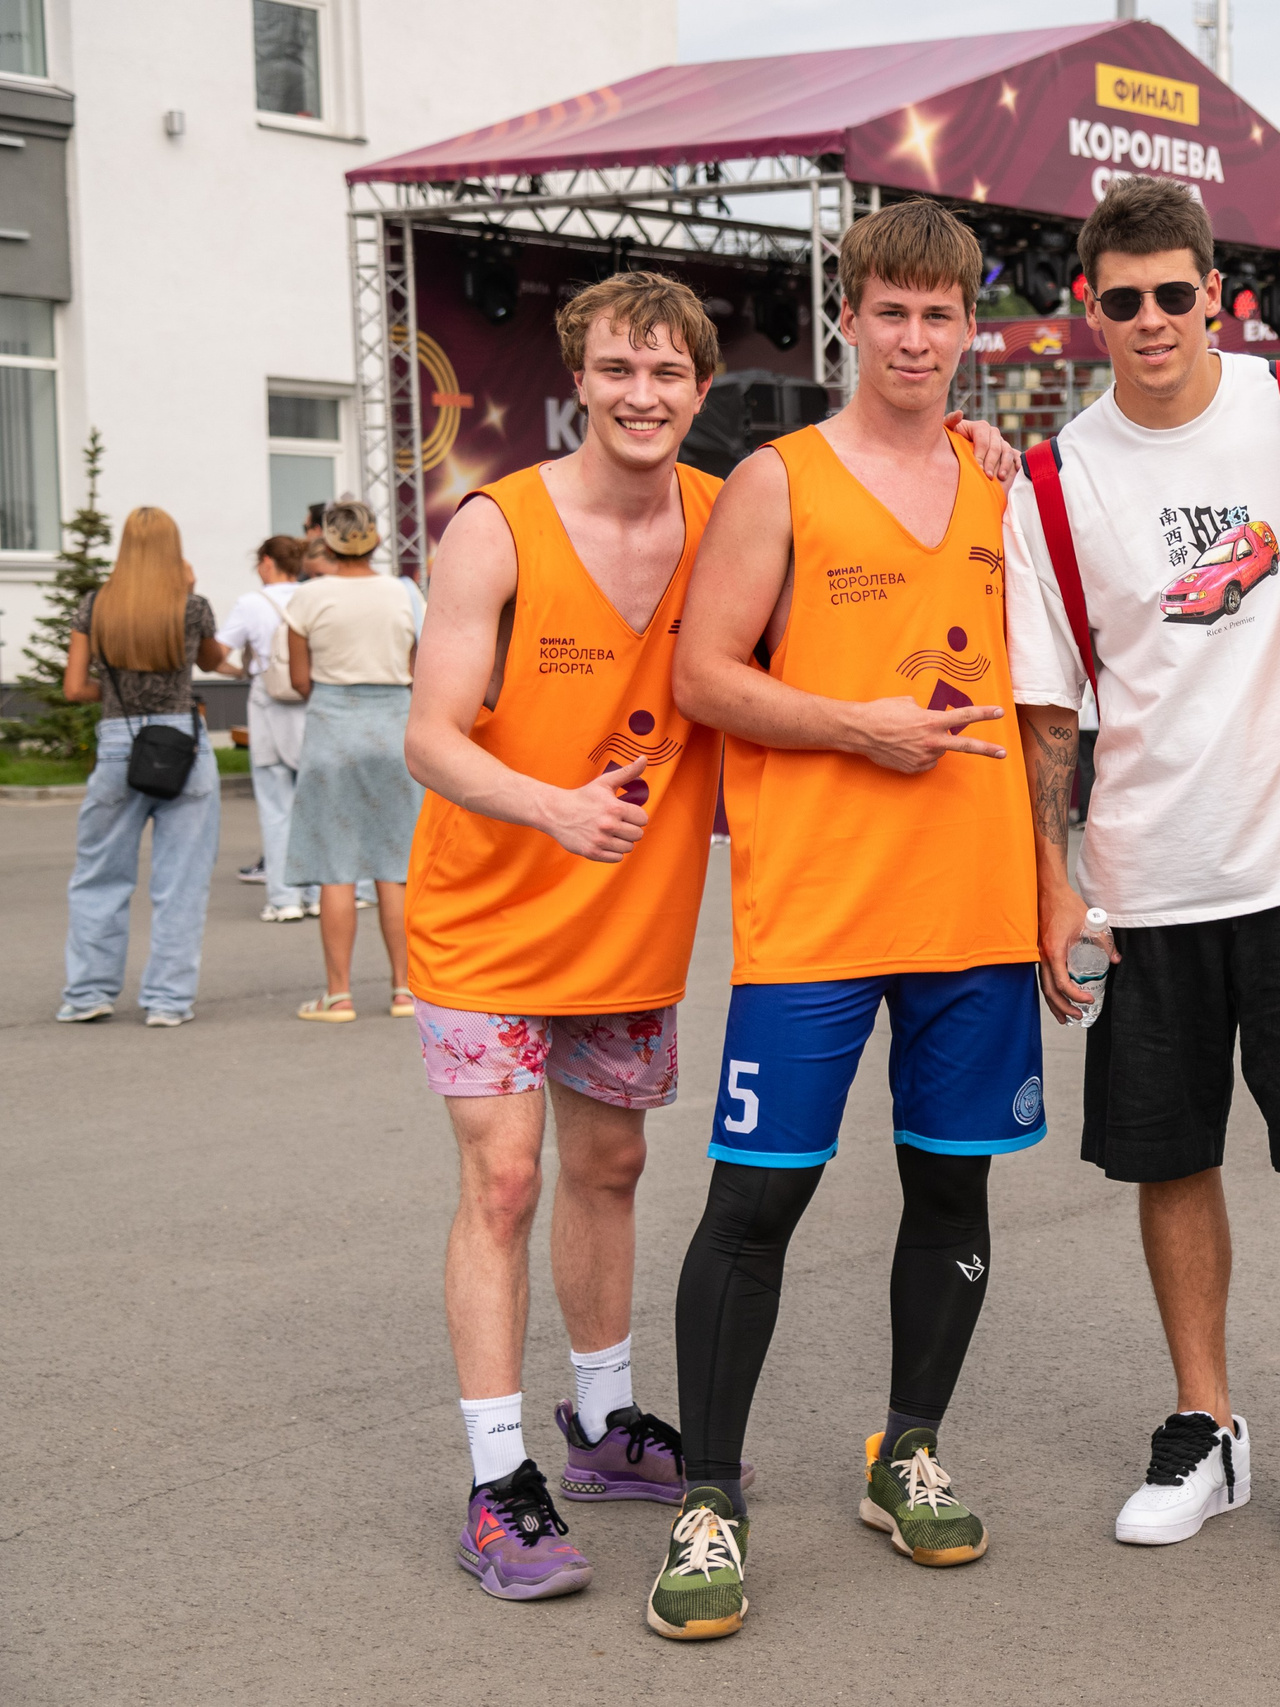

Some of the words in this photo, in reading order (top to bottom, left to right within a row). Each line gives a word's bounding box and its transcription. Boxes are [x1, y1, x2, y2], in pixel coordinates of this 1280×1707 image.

[1114, 77, 1184, 114] ФИНАЛ
[1069, 117, 1225, 184] КОРОЛЕВА
[827, 565, 863, 578] ФИНАЛ
[829, 573, 906, 591] КОРОЛЕВА
[830, 588, 888, 606] СПОРТА
[1206, 627, 1222, 637] Rice
[1229, 616, 1256, 629] Premier
[540, 637, 575, 646] ФИНАЛ
[540, 647, 615, 661] КОРОЛЕВА
[539, 662, 594, 675] СПОРТА
[724, 1059, 760, 1135] 5
[488, 1422, 522, 1434] JÖGE
